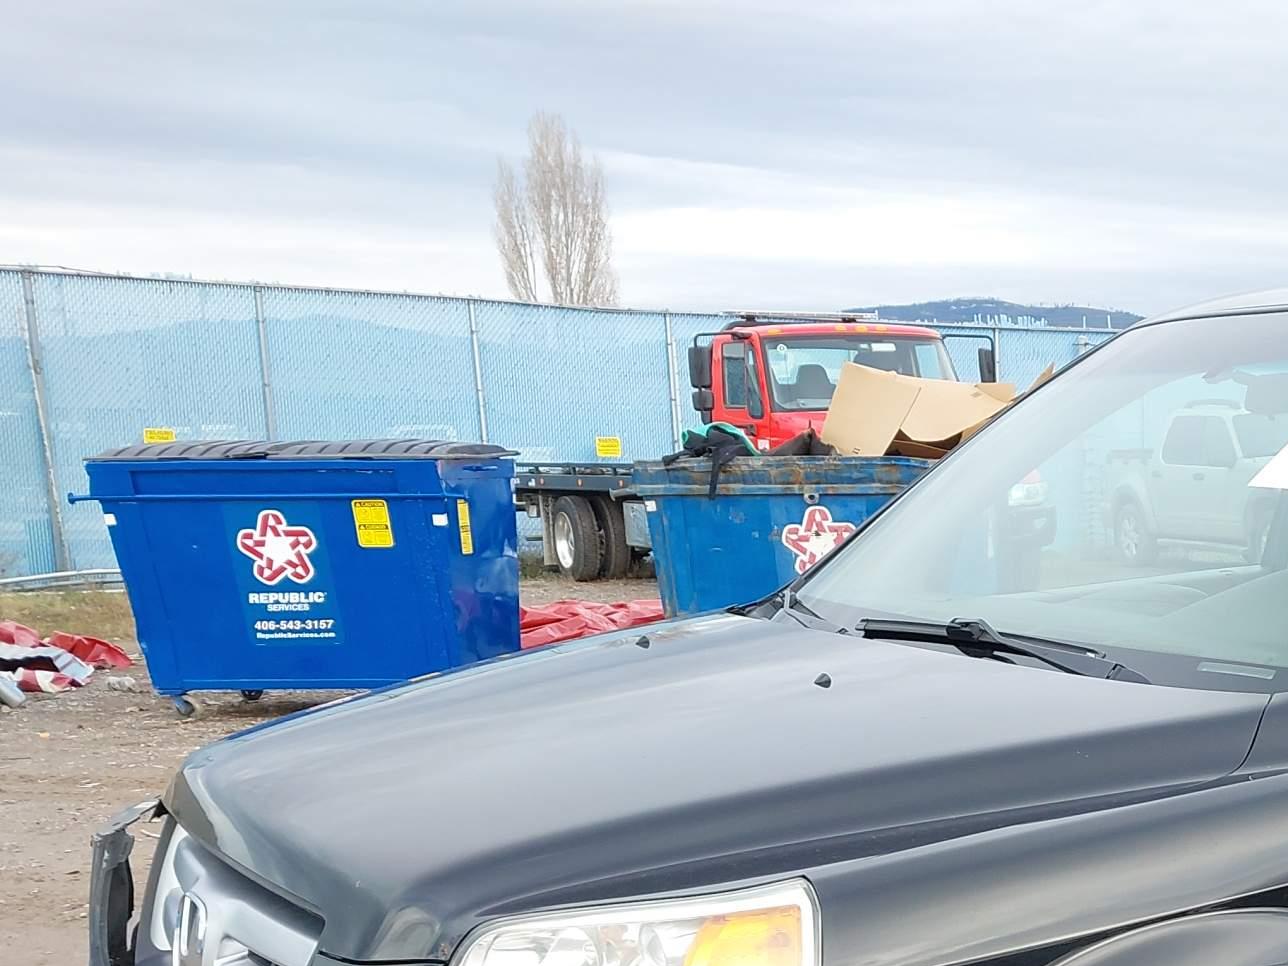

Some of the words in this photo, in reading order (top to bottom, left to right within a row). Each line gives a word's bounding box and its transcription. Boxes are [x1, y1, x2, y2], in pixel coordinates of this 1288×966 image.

[248, 591, 325, 604] REPUBLIC
[267, 603, 310, 612] SERVICES
[254, 619, 335, 630] 406-543-3157
